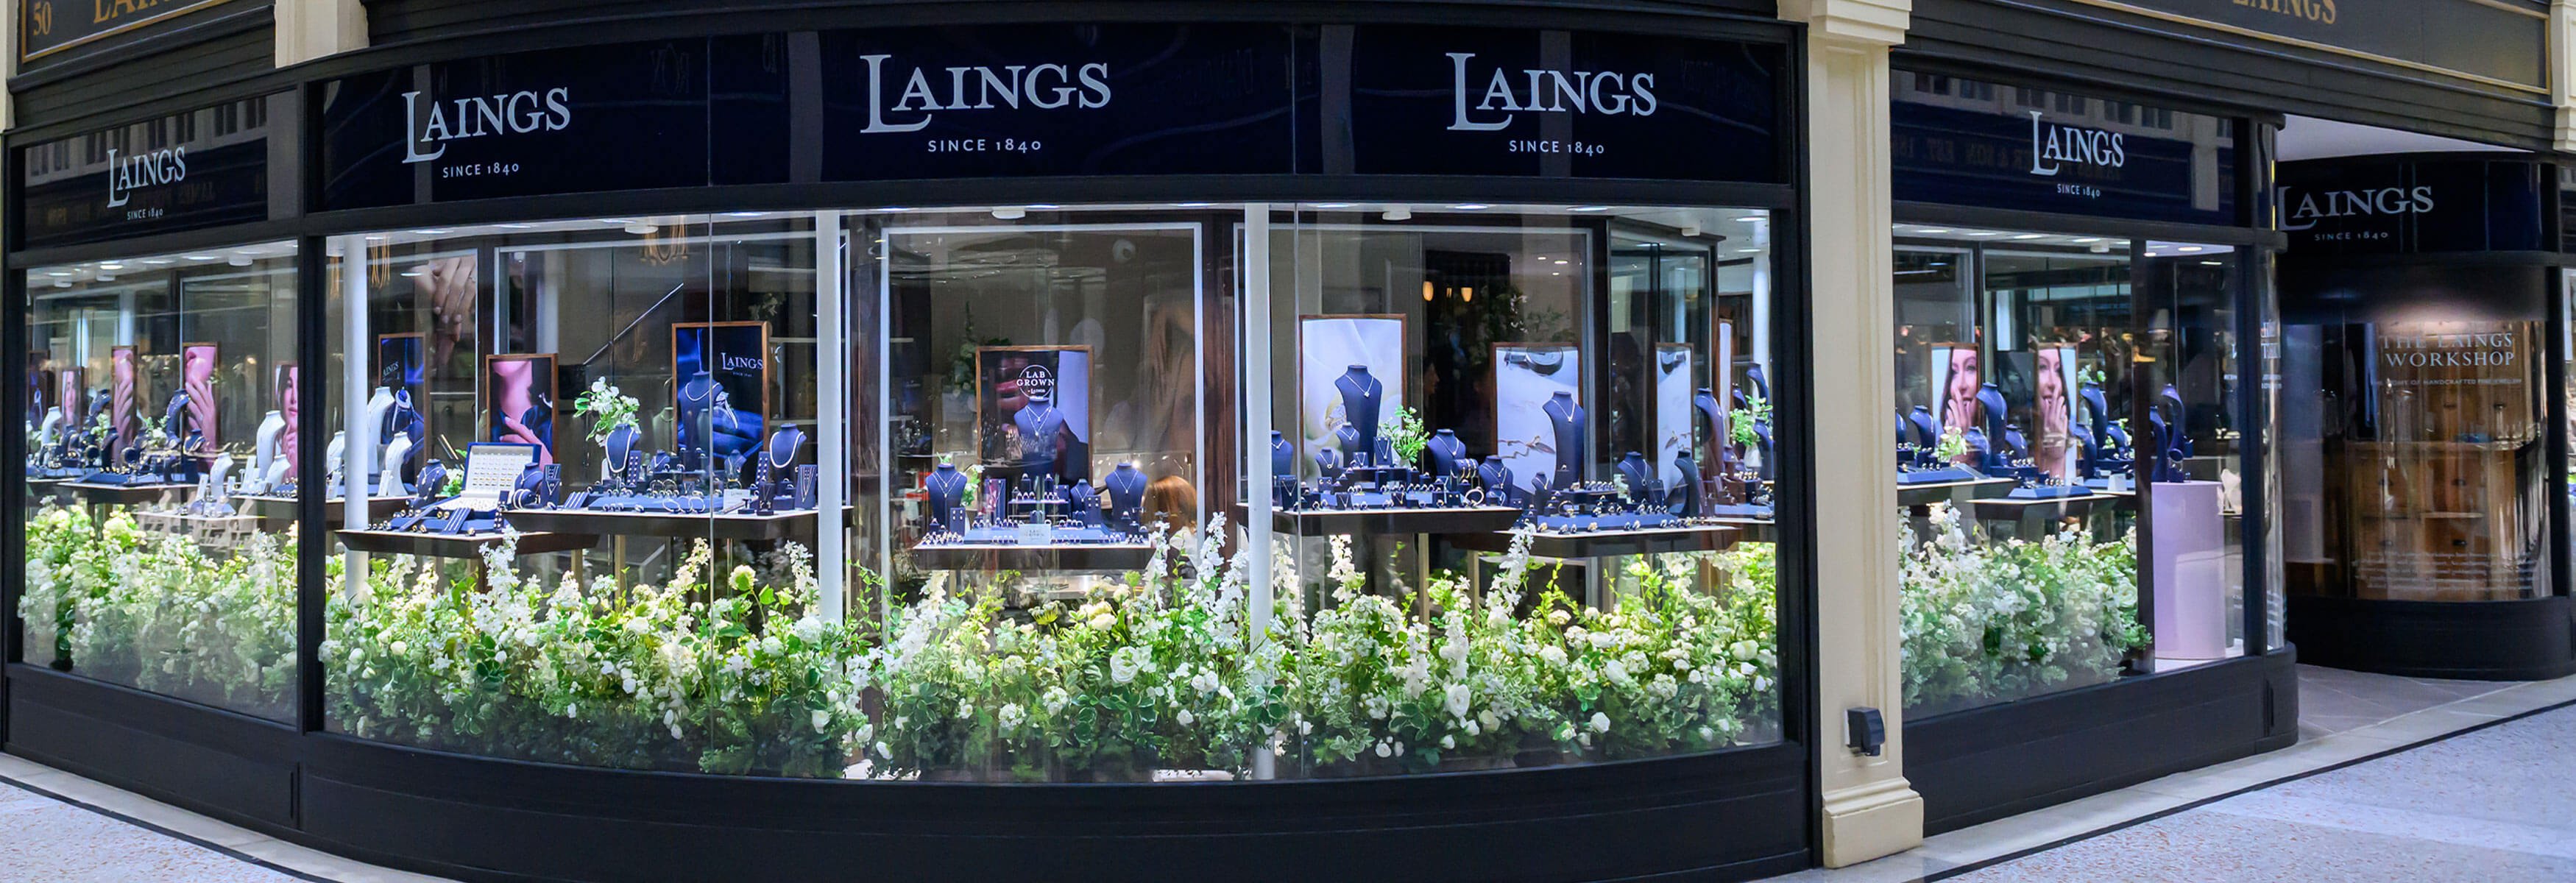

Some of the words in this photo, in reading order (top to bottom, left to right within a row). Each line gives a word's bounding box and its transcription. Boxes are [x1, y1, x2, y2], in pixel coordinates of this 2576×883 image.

[32, 1, 52, 36] 50
[860, 54, 1112, 133] LAINGS
[1446, 52, 1657, 131] LAINGS
[402, 87, 571, 164] LAINGS
[928, 139, 986, 153] SINCE
[995, 138, 1042, 154] 1840
[1510, 140, 1560, 154] SINCE
[1567, 141, 1604, 157] 1840
[2030, 110, 2124, 176] LAINGS
[107, 146, 185, 209] LAINGS
[442, 164, 481, 179] SINCE
[487, 162, 520, 177] 1840
[2057, 183, 2080, 196] SINCE
[2082, 186, 2101, 199] 1840
[127, 210, 146, 221] SINCE
[148, 208, 163, 219] 1840
[2277, 185, 2435, 231] LAINGS
[2314, 232, 2352, 241] SINCE
[2357, 231, 2389, 241] 1840
[2384, 336, 2427, 349] THE
[2437, 333, 2513, 348] LAINGS
[721, 352, 764, 370] LAINGS
[2385, 351, 2515, 367] WORKSHOP
